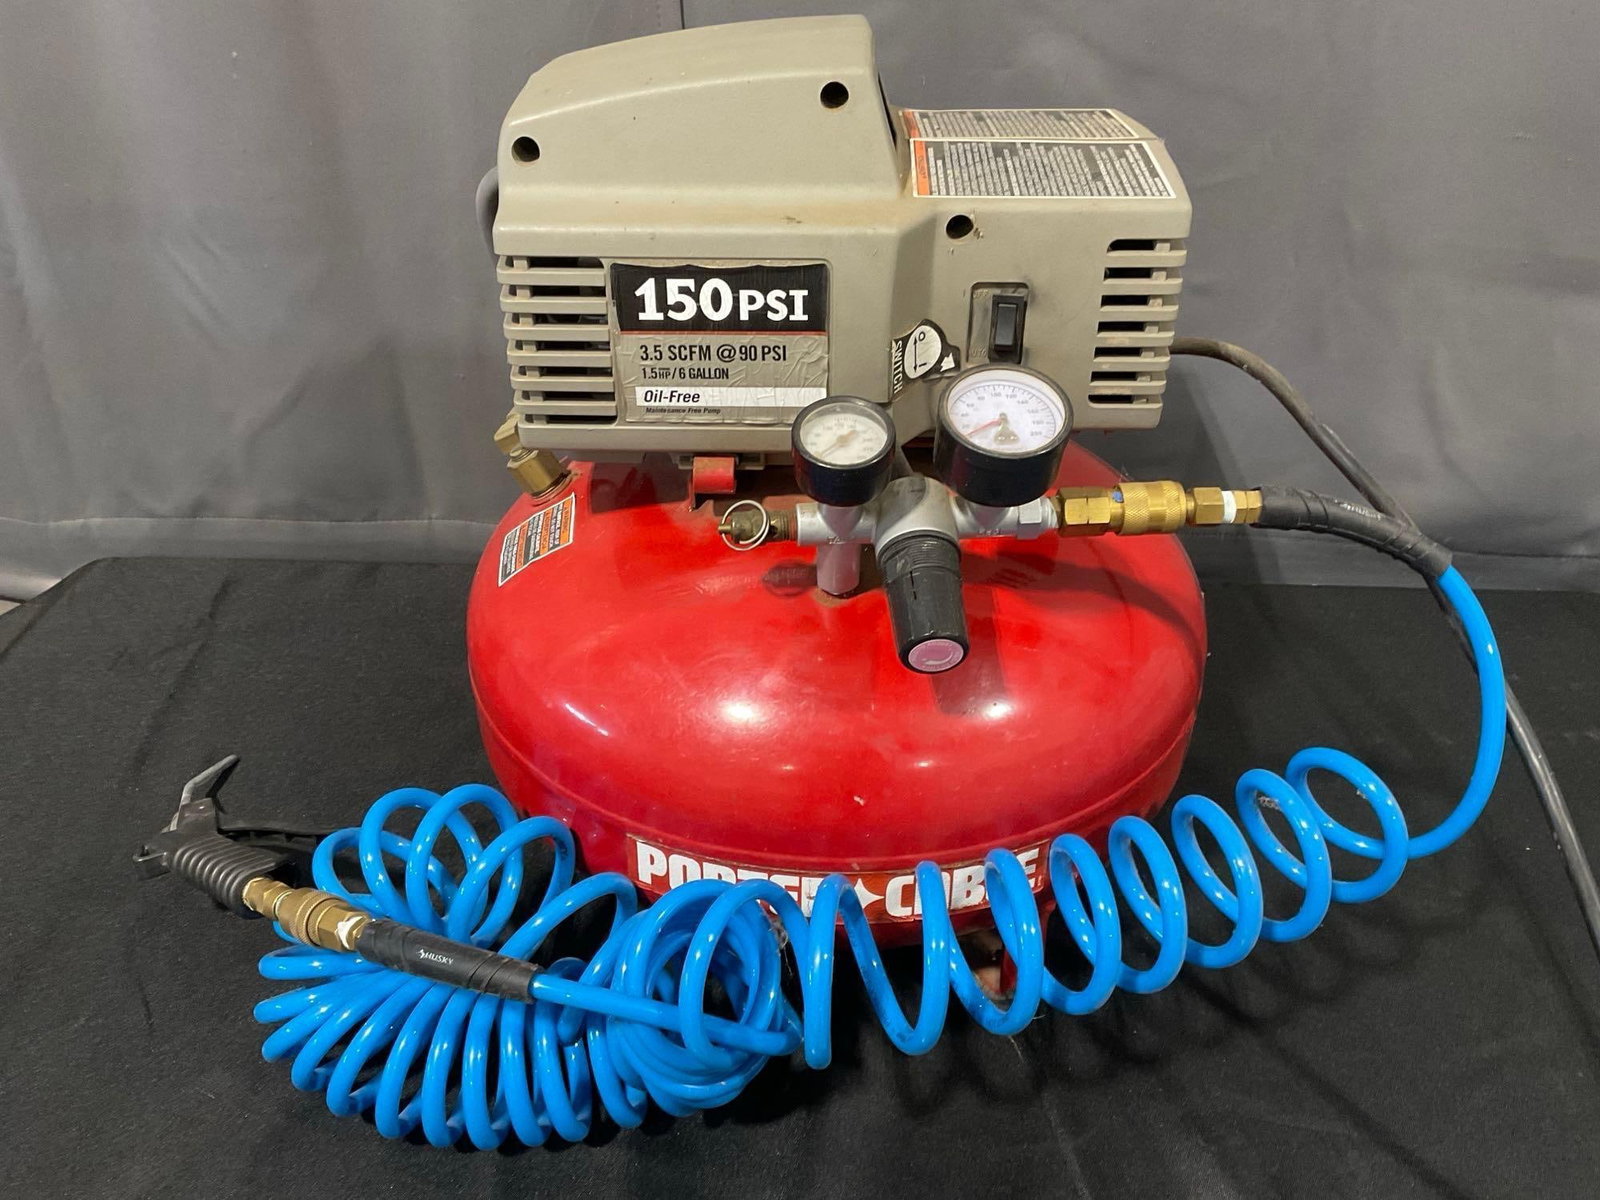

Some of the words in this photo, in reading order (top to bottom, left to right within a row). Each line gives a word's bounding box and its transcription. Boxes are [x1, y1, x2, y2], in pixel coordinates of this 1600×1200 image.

[634, 277, 734, 321] 150
[738, 289, 809, 321] PSI
[640, 344, 663, 361] 3.5
[667, 344, 712, 361] SCFM
[739, 345, 758, 362] 90
[761, 345, 787, 362] PSI
[688, 367, 730, 380] GALLON
[893, 340, 903, 395] SWITCH
[643, 389, 701, 404] Oil-Free
[885, 848, 1040, 918] CBE
[424, 951, 454, 965] HUSKY
